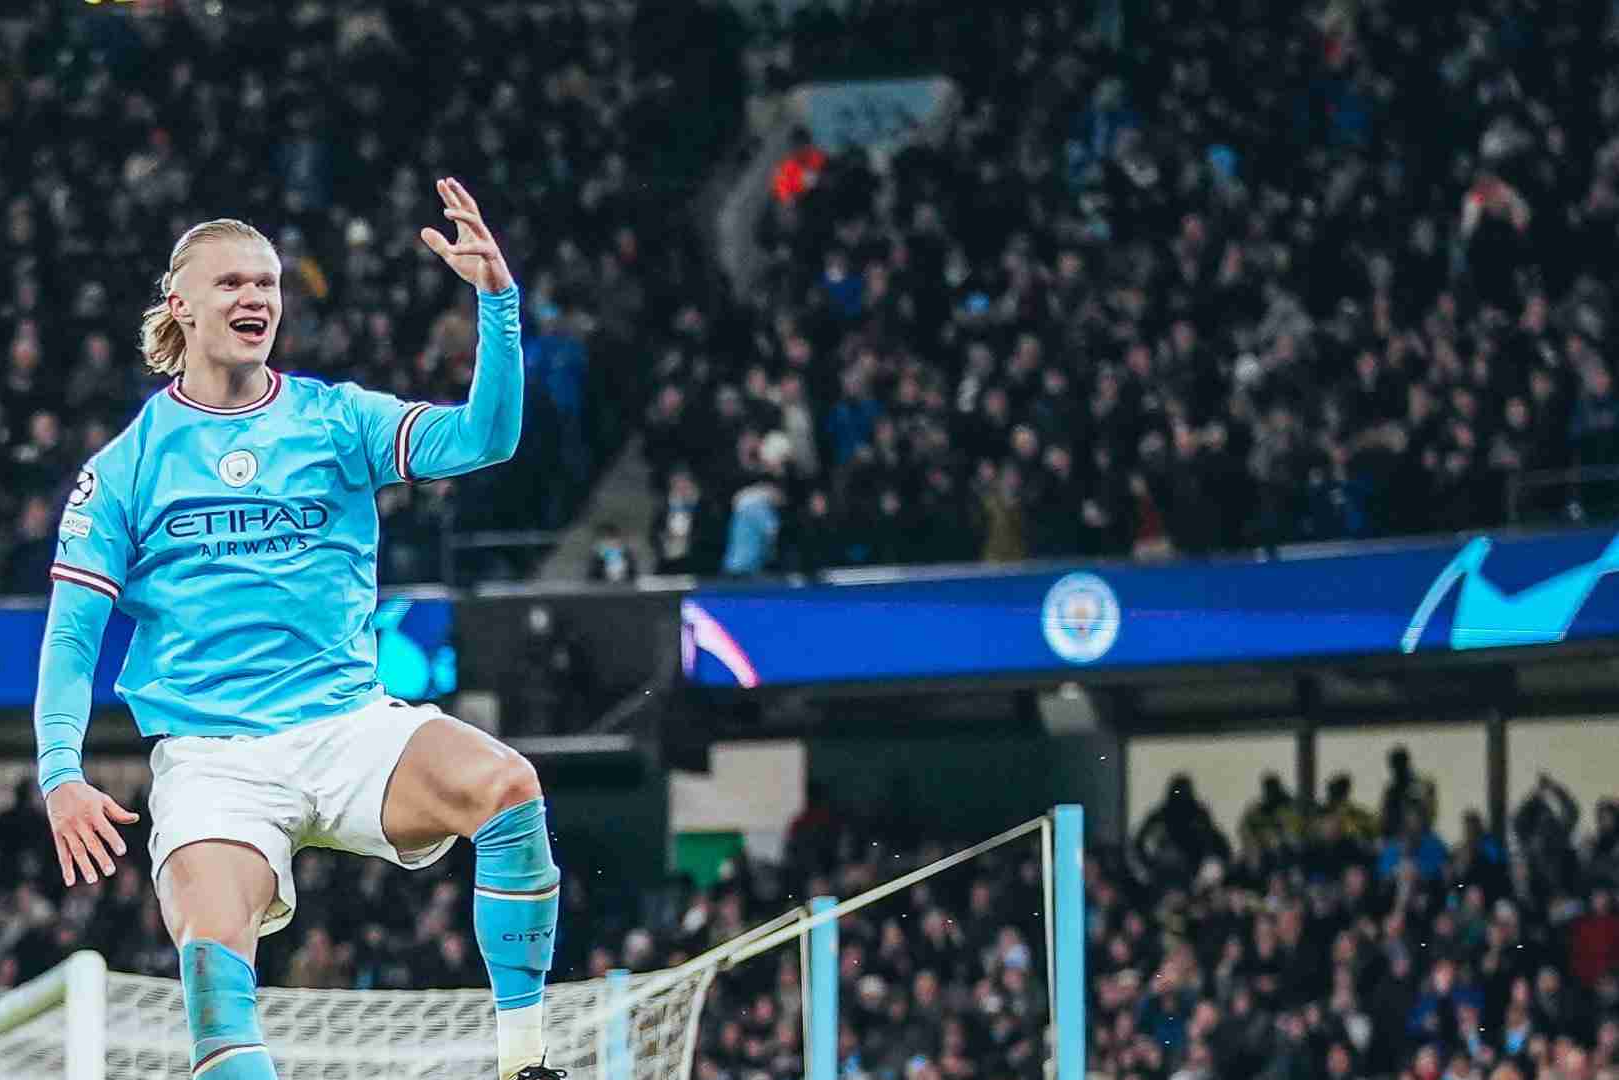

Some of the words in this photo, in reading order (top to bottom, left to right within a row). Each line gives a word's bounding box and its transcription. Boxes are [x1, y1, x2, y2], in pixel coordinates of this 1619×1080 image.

[165, 504, 328, 538] ETIHAD
[200, 534, 309, 557] AIRWAYS
[501, 926, 554, 942] CITY
